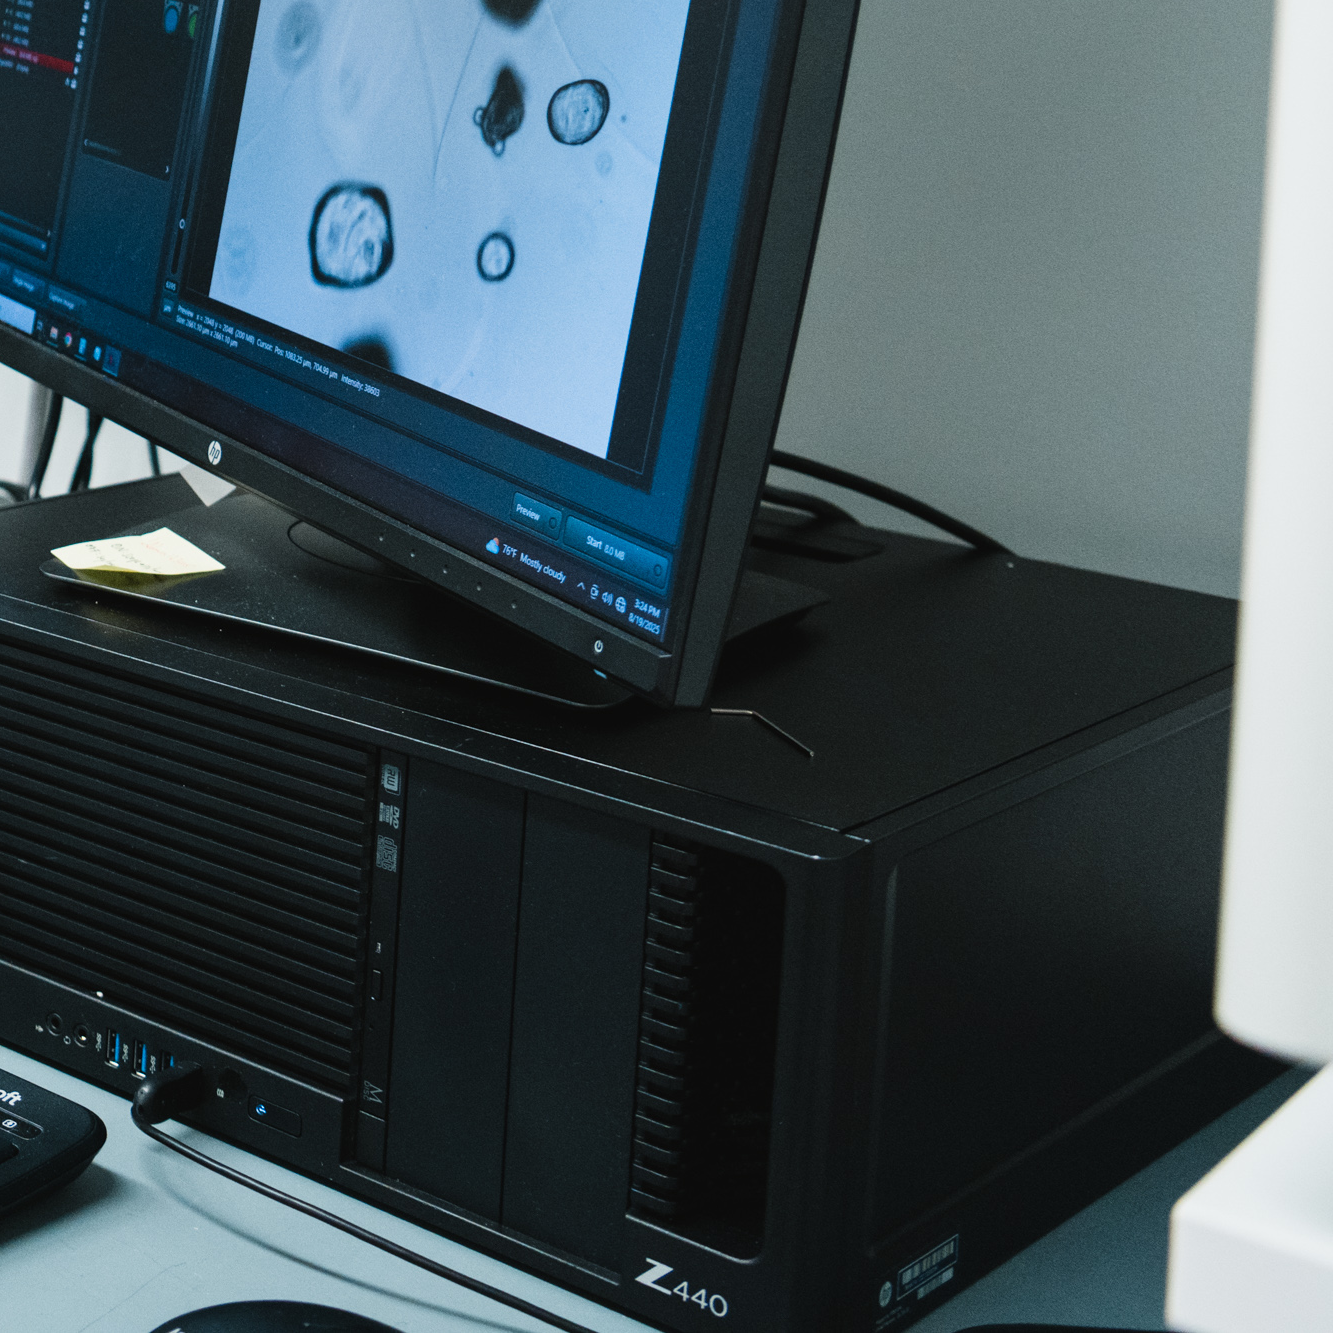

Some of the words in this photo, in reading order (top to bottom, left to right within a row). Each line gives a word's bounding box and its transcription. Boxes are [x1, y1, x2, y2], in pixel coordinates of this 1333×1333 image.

[177, 304, 194, 319] Preview
[256, 338, 273, 352] Cursor:
[340, 373, 364, 392] Intensity:
[209, 440, 221, 464] hp
[516, 503, 541, 521] Preview
[586, 535, 602, 551] Start
[614, 549, 626, 561] MB
[502, 543, 518, 559] 76°F
[520, 552, 543, 573] Mostly
[543, 565, 567, 584] cloudy
[634, 598, 648, 613] 3:24
[648, 604, 661, 618] PM
[628, 612, 661, 635] 8/19/2025
